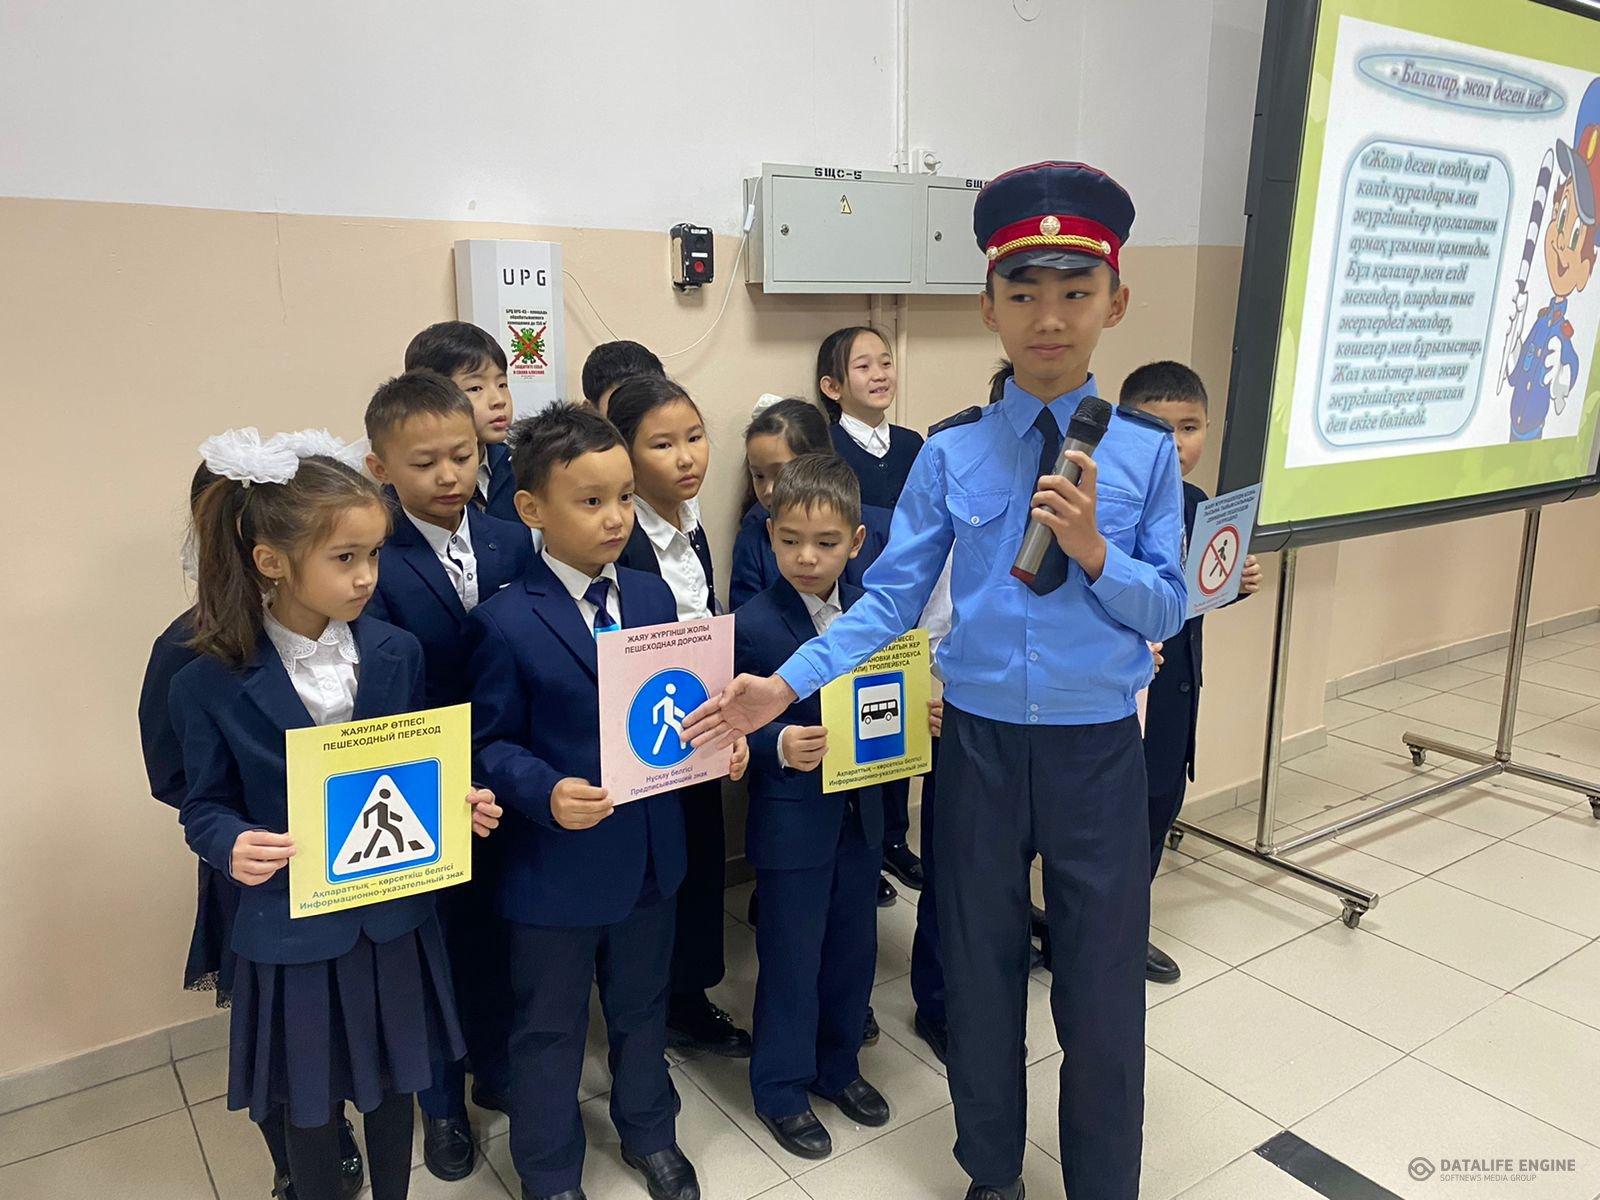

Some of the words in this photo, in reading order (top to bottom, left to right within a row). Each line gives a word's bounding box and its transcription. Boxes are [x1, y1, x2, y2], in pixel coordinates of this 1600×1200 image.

[1401, 62, 1459, 97] Балалар,
[1463, 79, 1491, 98] жол
[1493, 80, 1526, 103] деген
[1526, 89, 1549, 108] не?
[1404, 153, 1436, 175] деген
[1454, 191, 1478, 206] мен
[503, 268, 547, 286] UPG
[1421, 267, 1444, 281] мен
[1445, 263, 1469, 282] елді
[1403, 287, 1449, 310] олардан
[1450, 293, 1475, 306] тыс
[1388, 342, 1413, 356] мен
[1331, 363, 1360, 383] Жол
[1414, 364, 1437, 379] мен
[1438, 363, 1469, 382] жаяу
[1326, 413, 1347, 433] деп
[627, 633, 649, 643] ЖАЯУ
[687, 624, 710, 634] ЖОЛЫ
[625, 640, 677, 654] ПЕШЕХОДНАЯ
[677, 634, 713, 647] ДОРОЖКА
[869, 659, 911, 671] ТРОЛЛЕЙБУСА
[892, 650, 922, 660] АВТОБУСА
[341, 722, 389, 738] ЖАЯУЛАР
[391, 717, 425, 730] ӨТПЕСІ
[323, 731, 396, 752] ПЕШЕХОДНЫЙ
[398, 725, 442, 740] ПЕРЕХОД
[630, 774, 692, 796] Предписывающий
[693, 771, 708, 780] знак
[424, 863, 454, 876] белгісі
[299, 873, 444, 910] Информационно-указательный
[446, 870, 464, 880] знак
